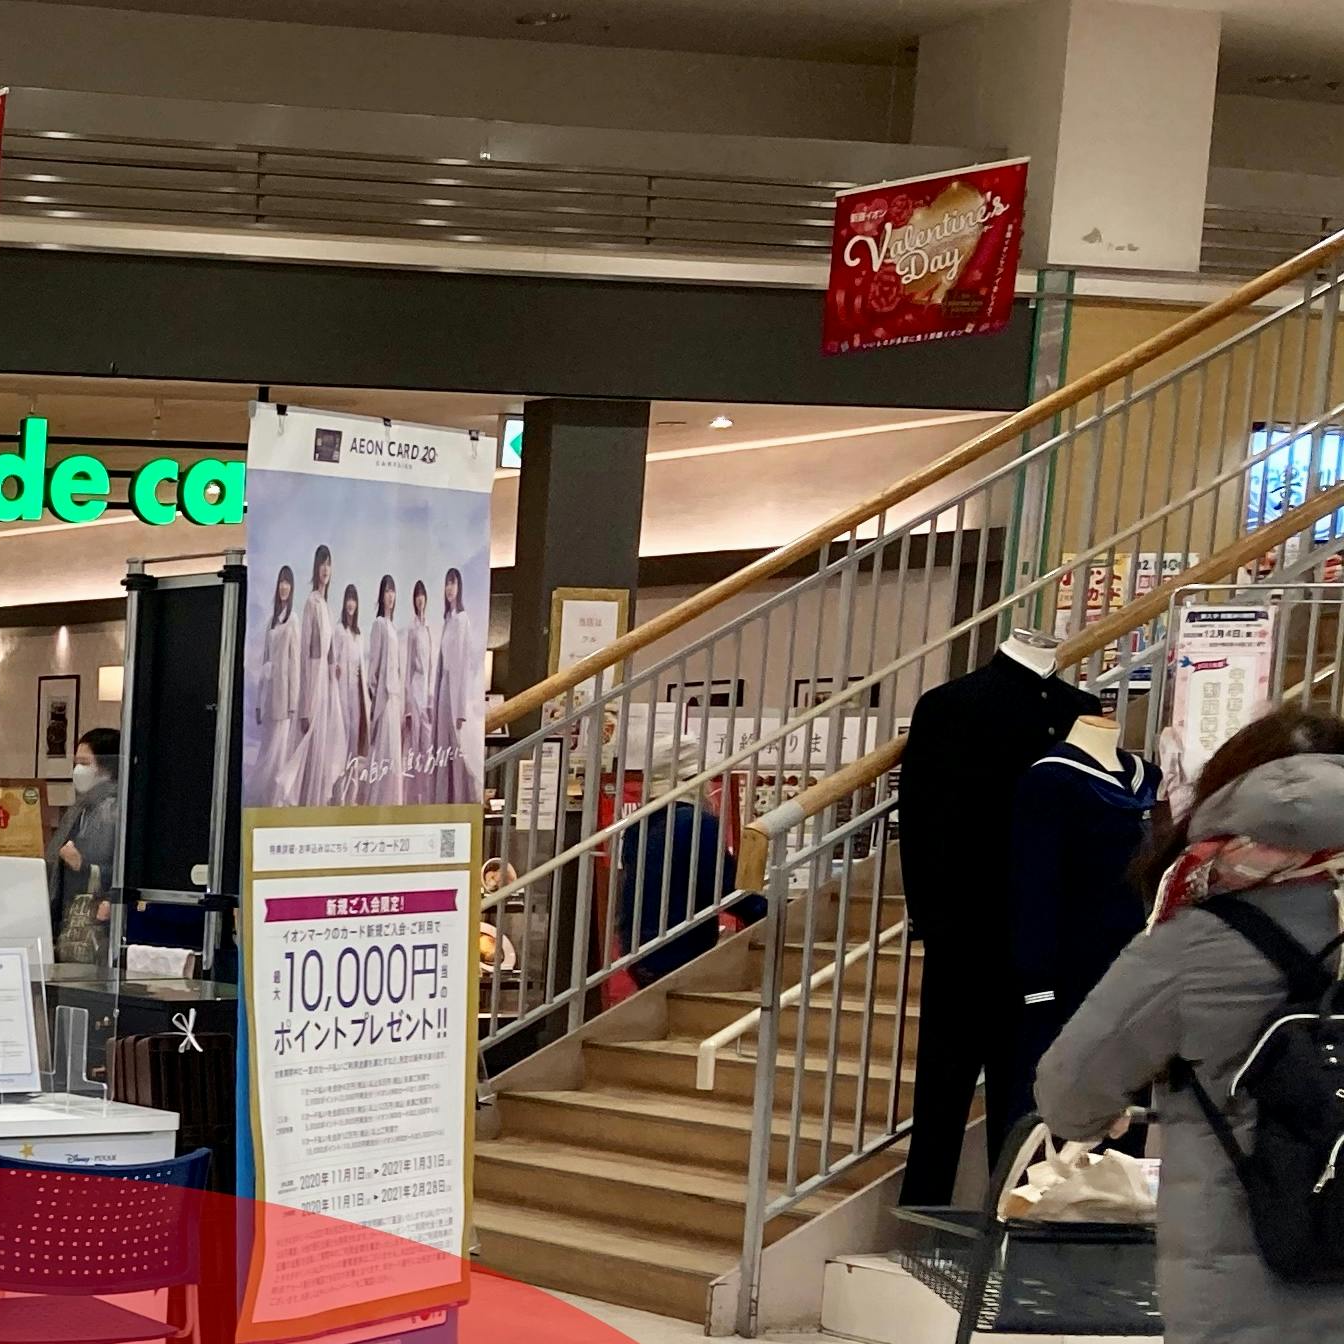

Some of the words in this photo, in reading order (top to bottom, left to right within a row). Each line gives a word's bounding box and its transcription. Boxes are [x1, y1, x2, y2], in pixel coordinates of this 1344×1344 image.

[844, 191, 1010, 272] Valentine's
[896, 249, 962, 285] Day
[350, 437, 383, 456] AEON
[388, 441, 420, 460] CARD
[326, 896, 405, 917] 新規ご入会限定!
[285, 943, 438, 1013] 10,000円
[274, 1008, 447, 1056] ポイントプレゼント!!
